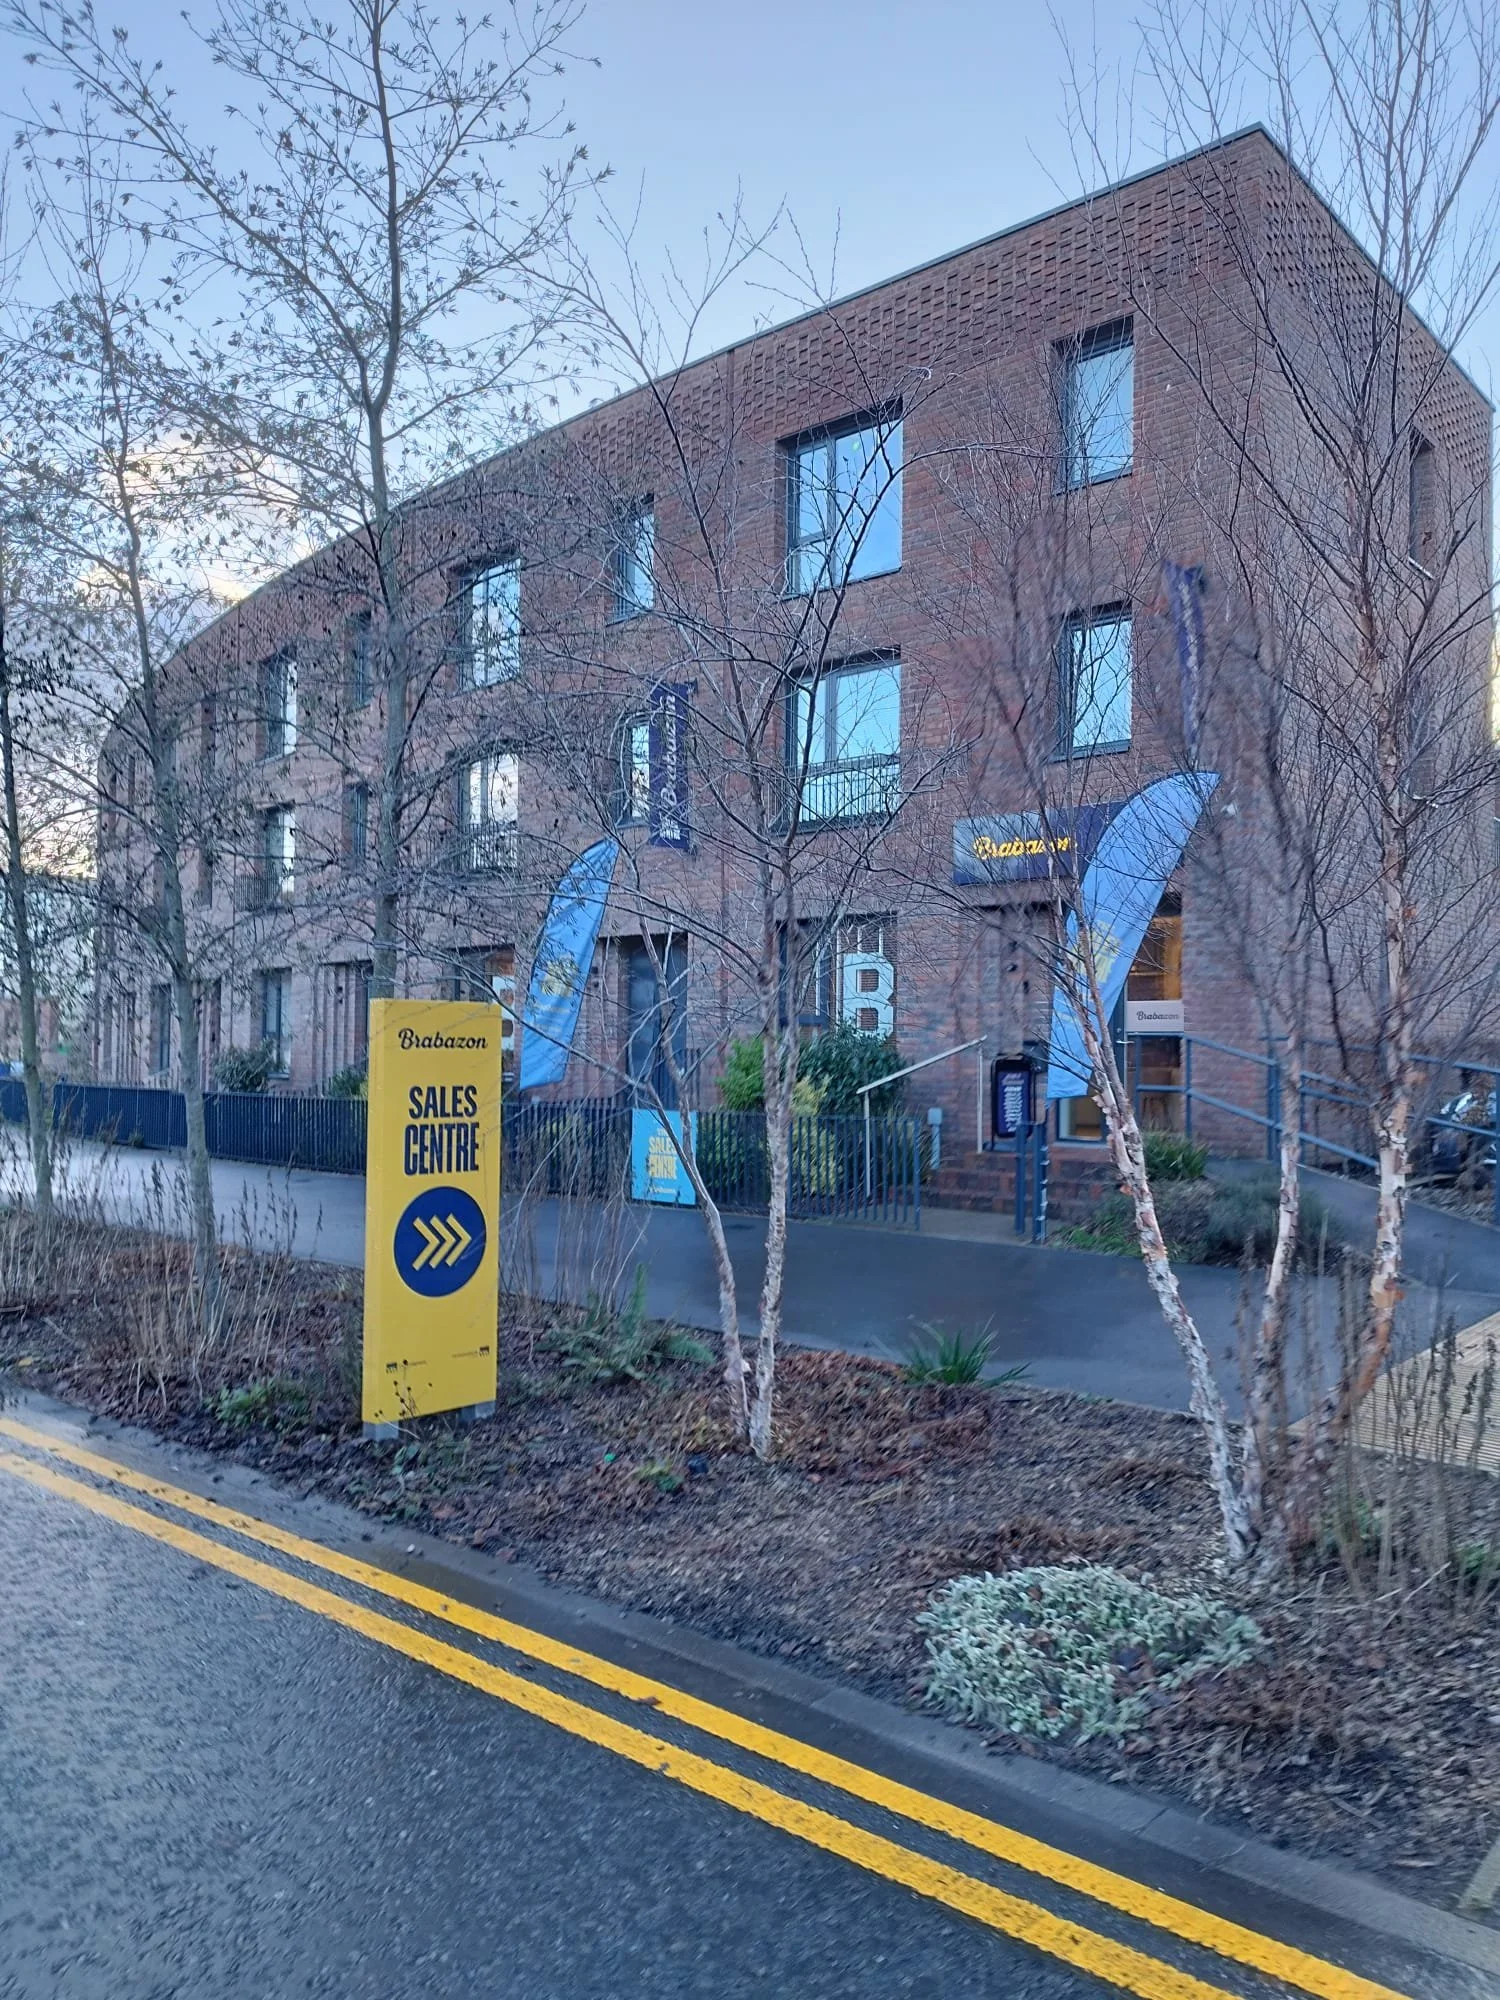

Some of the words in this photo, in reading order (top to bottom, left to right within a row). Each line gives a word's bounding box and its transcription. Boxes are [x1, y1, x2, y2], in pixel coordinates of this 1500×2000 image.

[1136, 1010, 1180, 1021] Brabazon
[398, 1027, 488, 1050] Brabazon
[408, 1084, 478, 1119] SALES
[404, 1121, 480, 1176] CENTRE
